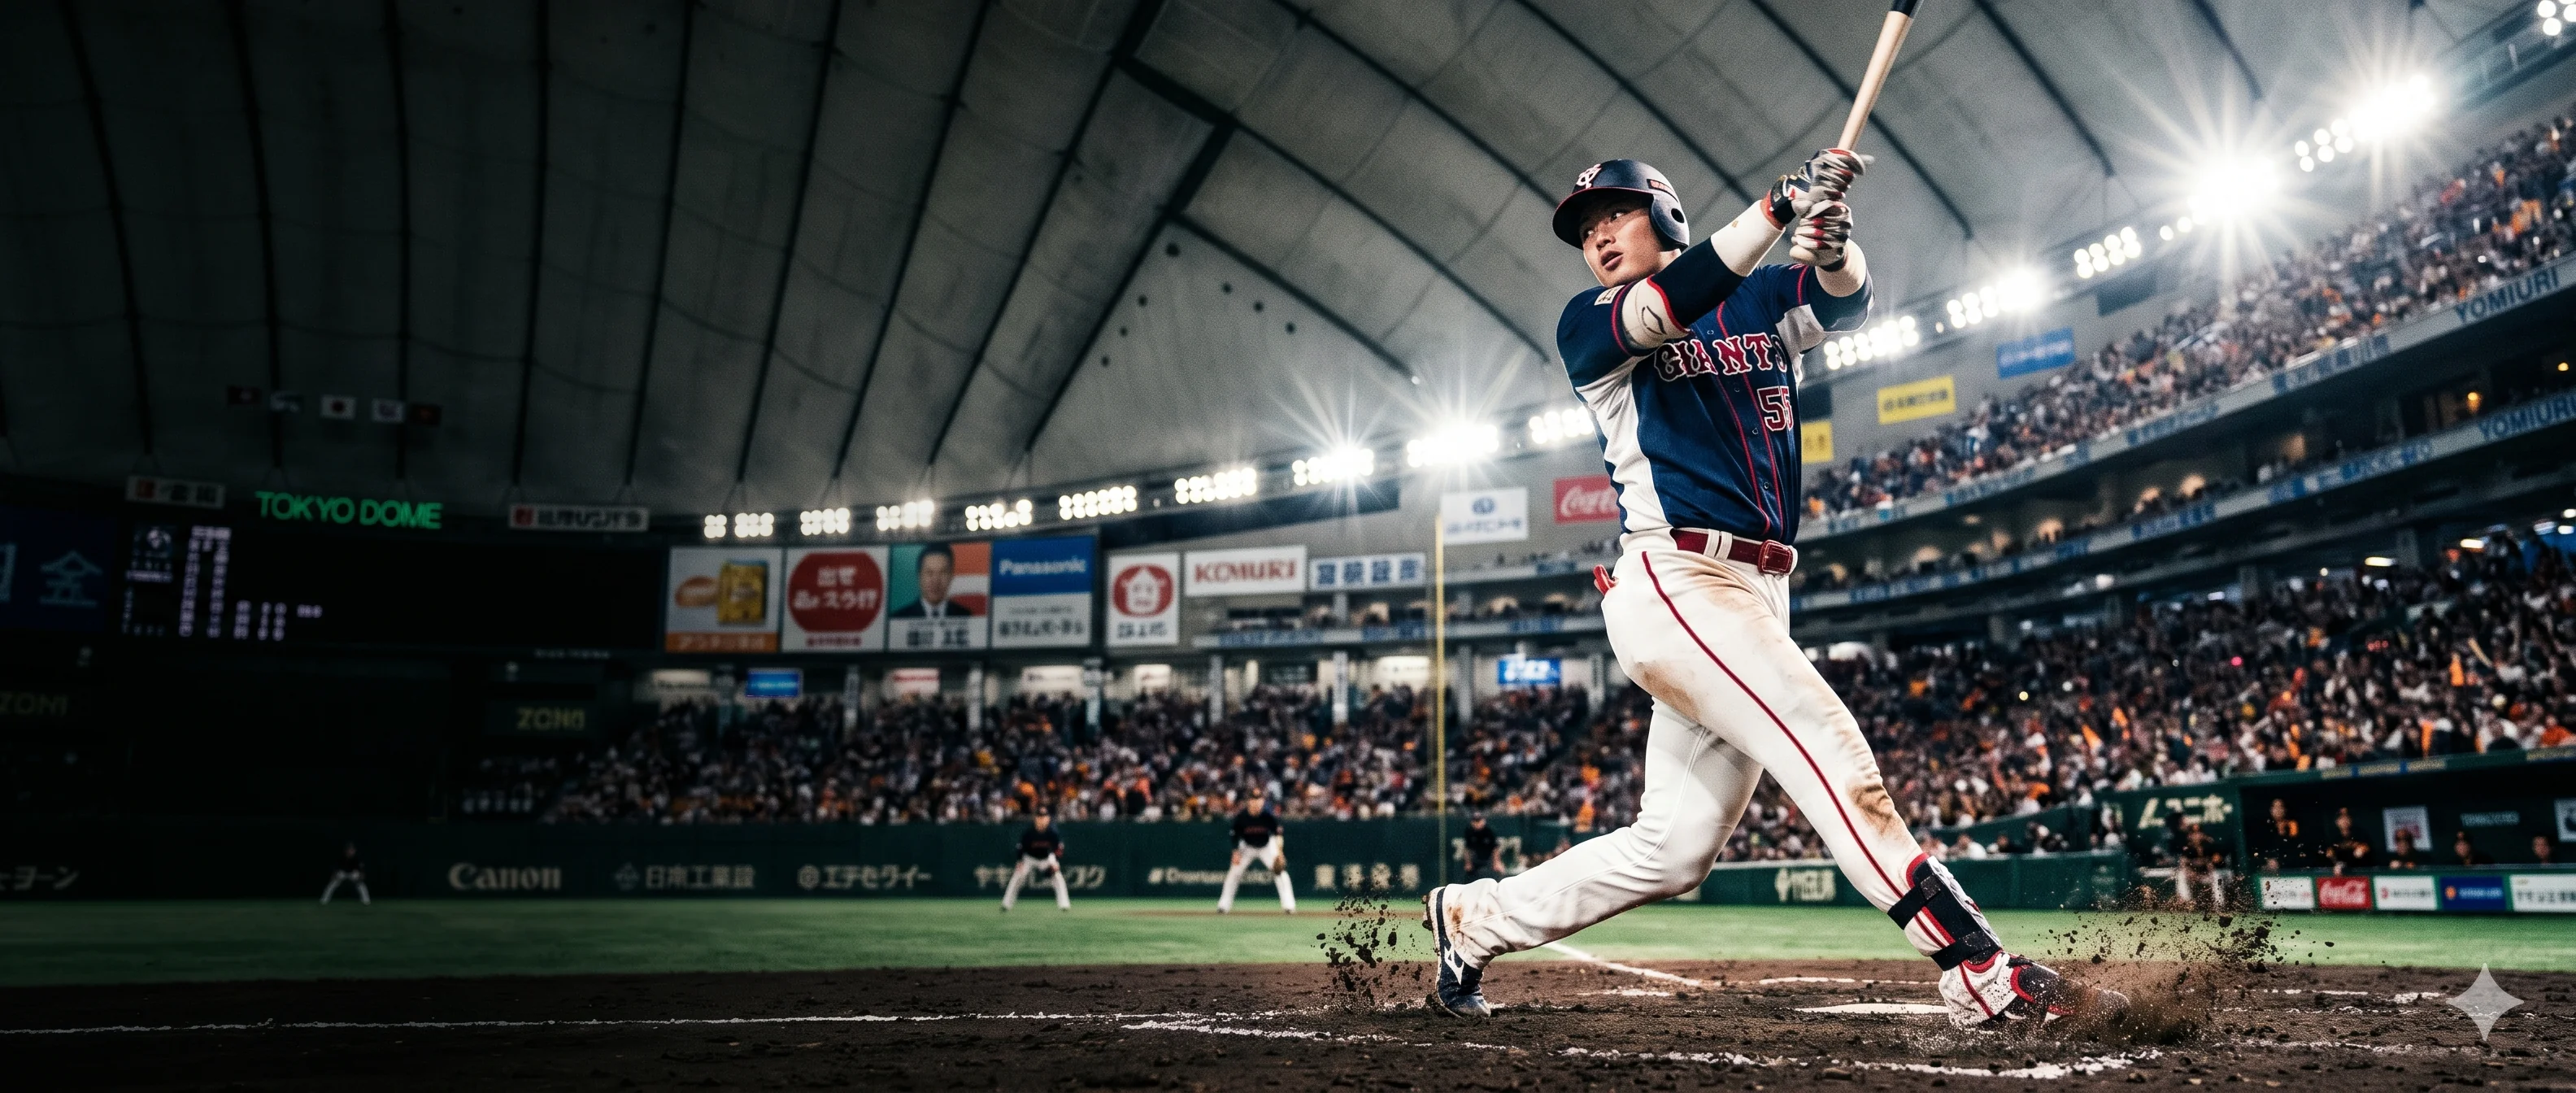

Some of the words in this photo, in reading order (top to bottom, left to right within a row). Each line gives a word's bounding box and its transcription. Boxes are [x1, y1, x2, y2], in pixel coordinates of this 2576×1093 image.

[2454, 267, 2560, 323] YOMIURI
[255, 490, 355, 525] TOKYO
[359, 499, 444, 530] DOME
[999, 555, 1086, 576] Panasonic
[447, 861, 562, 891] Canon
